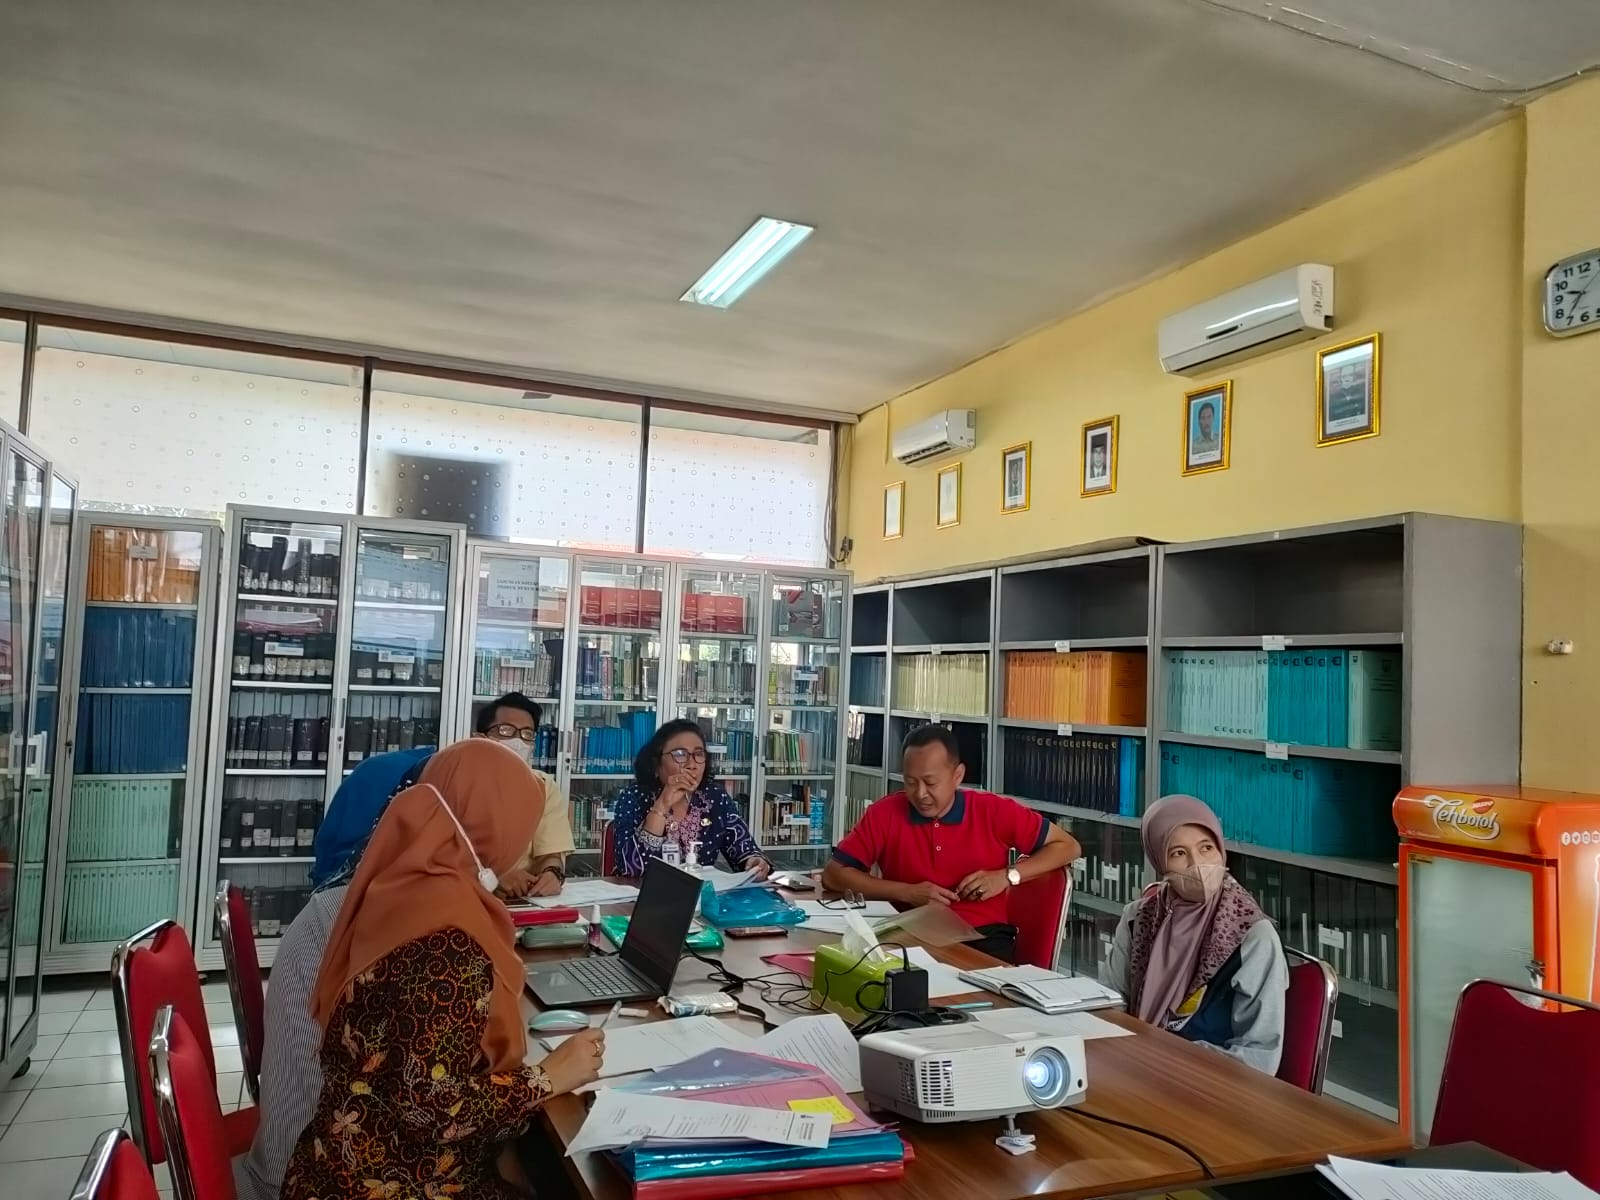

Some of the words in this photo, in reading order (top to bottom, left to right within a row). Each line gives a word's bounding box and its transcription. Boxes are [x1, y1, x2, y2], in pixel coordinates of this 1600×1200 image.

[1563, 267, 1574, 278] 11
[1577, 262, 1591, 274] 12
[1555, 280, 1568, 291] 10
[1555, 295, 1564, 305] 9
[1556, 308, 1565, 319] 8
[1580, 311, 1590, 322] 6
[1566, 315, 1574, 326] 7
